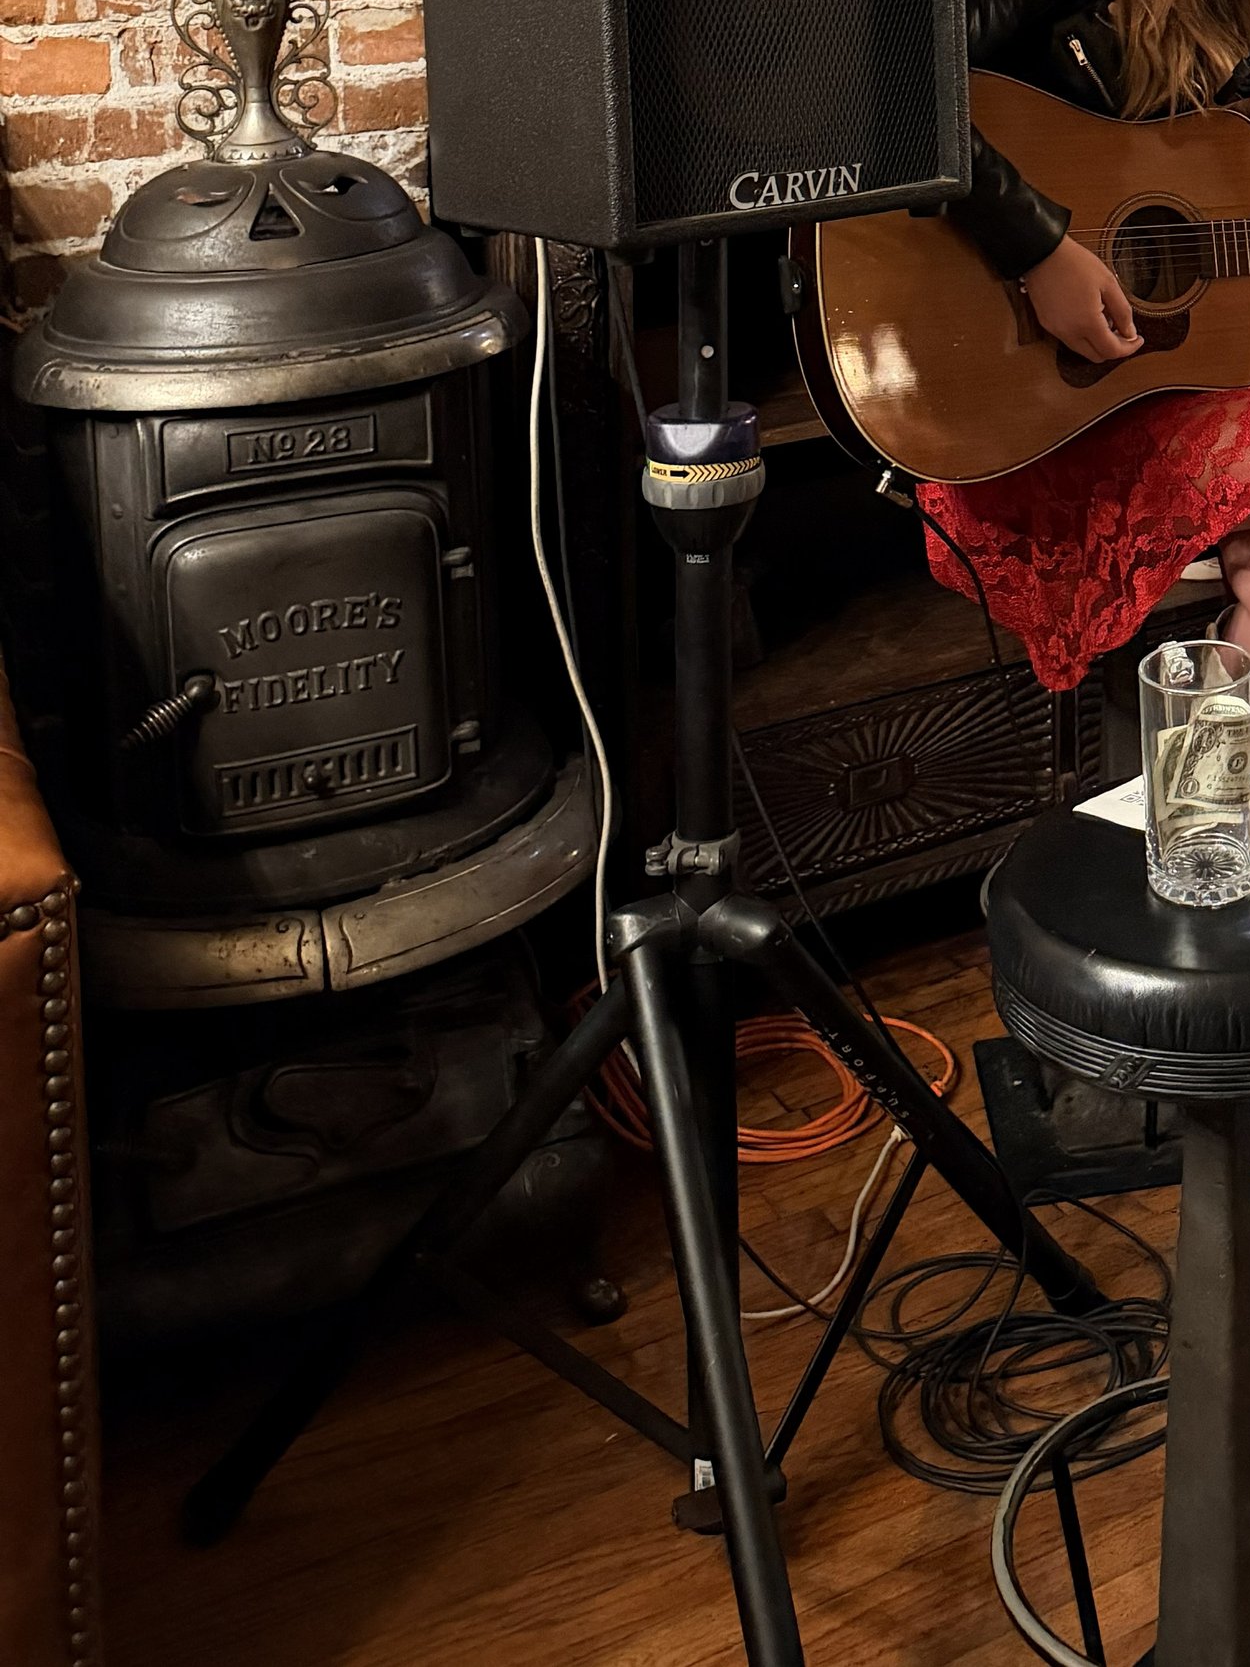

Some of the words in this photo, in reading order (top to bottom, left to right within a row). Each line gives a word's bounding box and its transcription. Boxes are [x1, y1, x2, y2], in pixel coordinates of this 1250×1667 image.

[729, 163, 862, 210] CARVIN
[303, 425, 351, 457] 28
[219, 591, 402, 660] MOORE'S
[222, 648, 405, 714] FIDELITY
